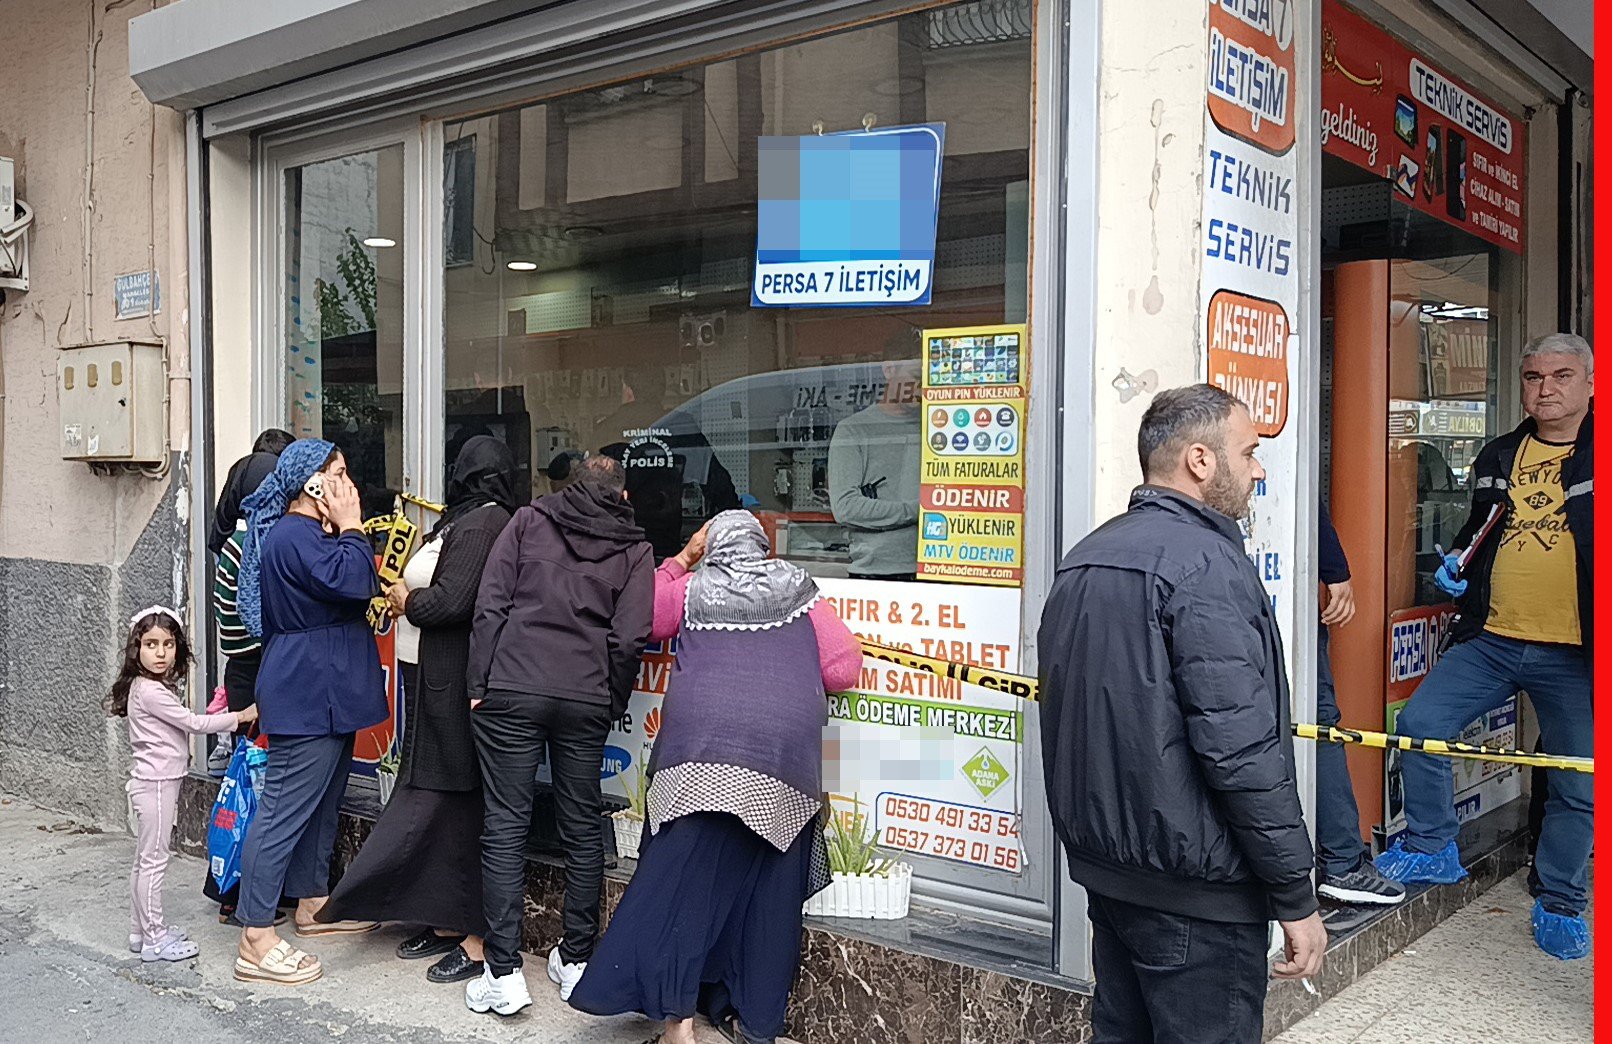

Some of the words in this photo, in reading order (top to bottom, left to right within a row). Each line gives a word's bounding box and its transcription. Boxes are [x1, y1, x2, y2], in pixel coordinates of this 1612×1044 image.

[1210, 33, 1285, 126] İLETİŞİM
[1415, 66, 1463, 123] TEKNİK
[1466, 99, 1507, 149] SERVİS
[1321, 103, 1378, 166] geldiniz
[1210, 150, 1291, 214] TEKNİK
[1206, 219, 1291, 276] SERVİS
[762, 274, 817, 294] PERSA
[824, 272, 834, 293] 7
[839, 263, 921, 298] İLETİŞİM
[1212, 301, 1285, 359] AKSESUAR
[927, 389, 952, 400] OYUN
[622, 427, 672, 438] KRİMİNAL
[630, 456, 665, 468] POLİS
[926, 458, 950, 477] TÜM
[954, 461, 1019, 478] FATURALAR
[931, 485, 1010, 508] ÖDENİR
[1529, 495, 1548, 507] 89
[949, 514, 1016, 536] YÜKLENİR
[923, 544, 954, 559] MTV
[958, 542, 1014, 563] ÖDENİR
[1265, 553, 1281, 581] EL
[923, 563, 1013, 578] baykalodeme.com
[888, 601, 902, 623] &
[911, 603, 929, 626] 2.
[939, 604, 966, 629] EL
[921, 638, 1010, 669] TABLET
[1391, 622, 1426, 678] PERSA
[886, 669, 962, 701] SATIMI
[857, 694, 922, 727] ÖDEME
[927, 709, 1016, 740] MERKEZİ
[886, 797, 931, 822] 0530
[935, 806, 964, 828] 491
[968, 811, 992, 834] 33
[997, 816, 1019, 839] 54
[885, 826, 929, 850] 0537
[933, 834, 966, 858] 373
[970, 841, 989, 862] 01
[994, 846, 1018, 869] 56
